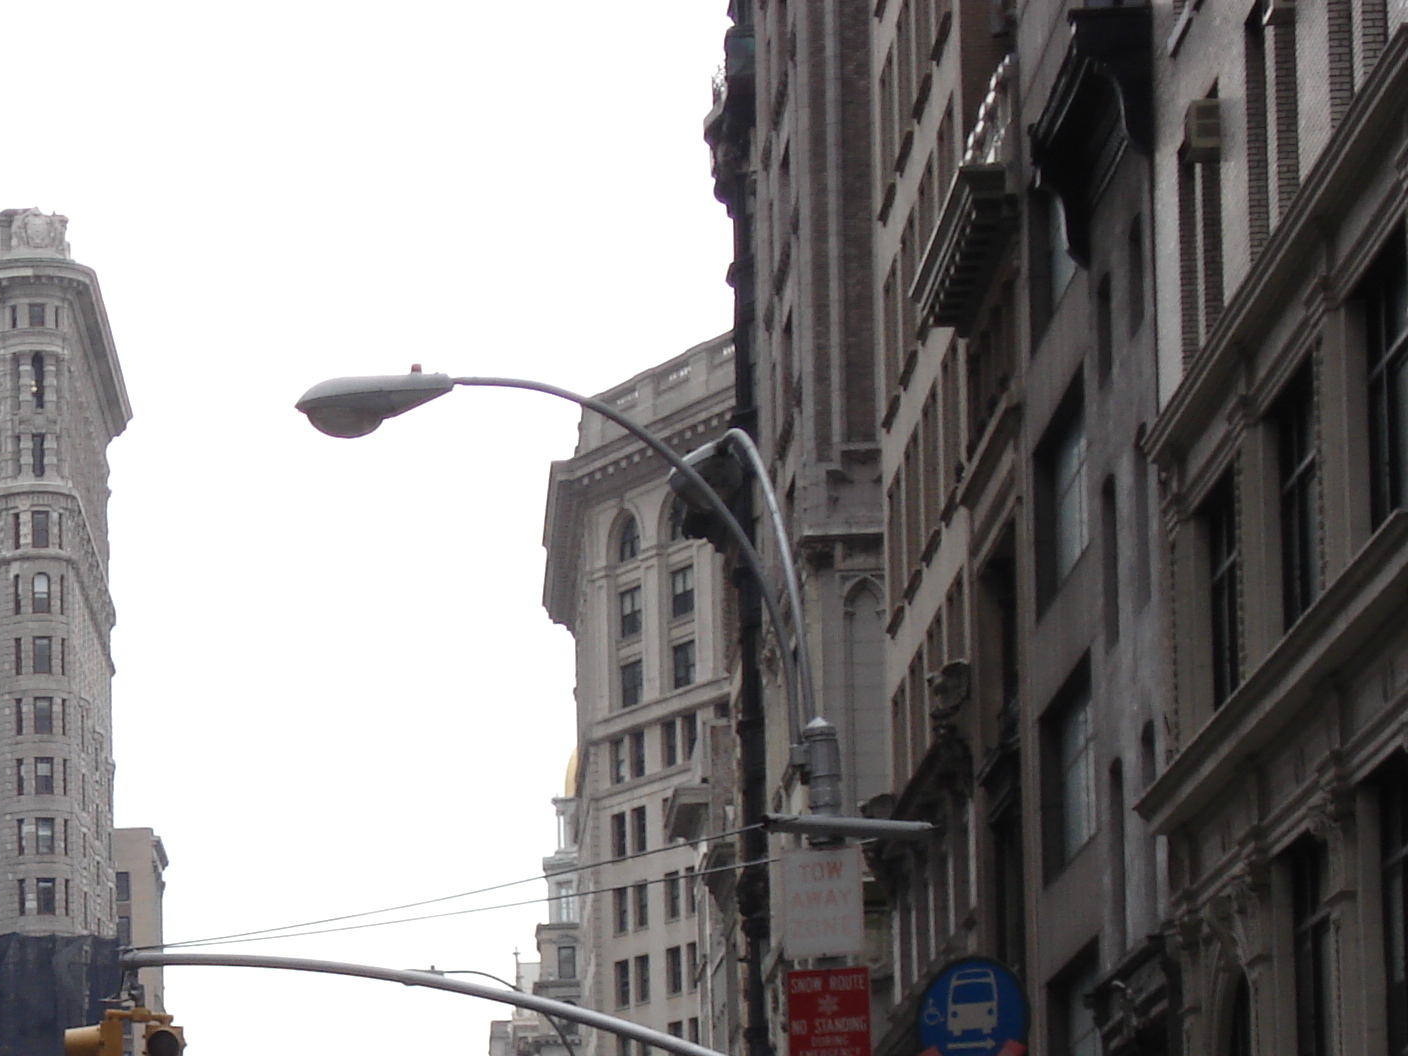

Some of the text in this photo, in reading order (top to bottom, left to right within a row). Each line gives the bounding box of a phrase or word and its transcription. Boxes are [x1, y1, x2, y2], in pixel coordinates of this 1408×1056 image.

[799, 861, 843, 882] TOW
[792, 888, 852, 908] AWAY
[791, 974, 867, 994] SNOW ROUTE
[791, 1016, 868, 1036] NO STANDING
[811, 1035, 849, 1047] DURING
